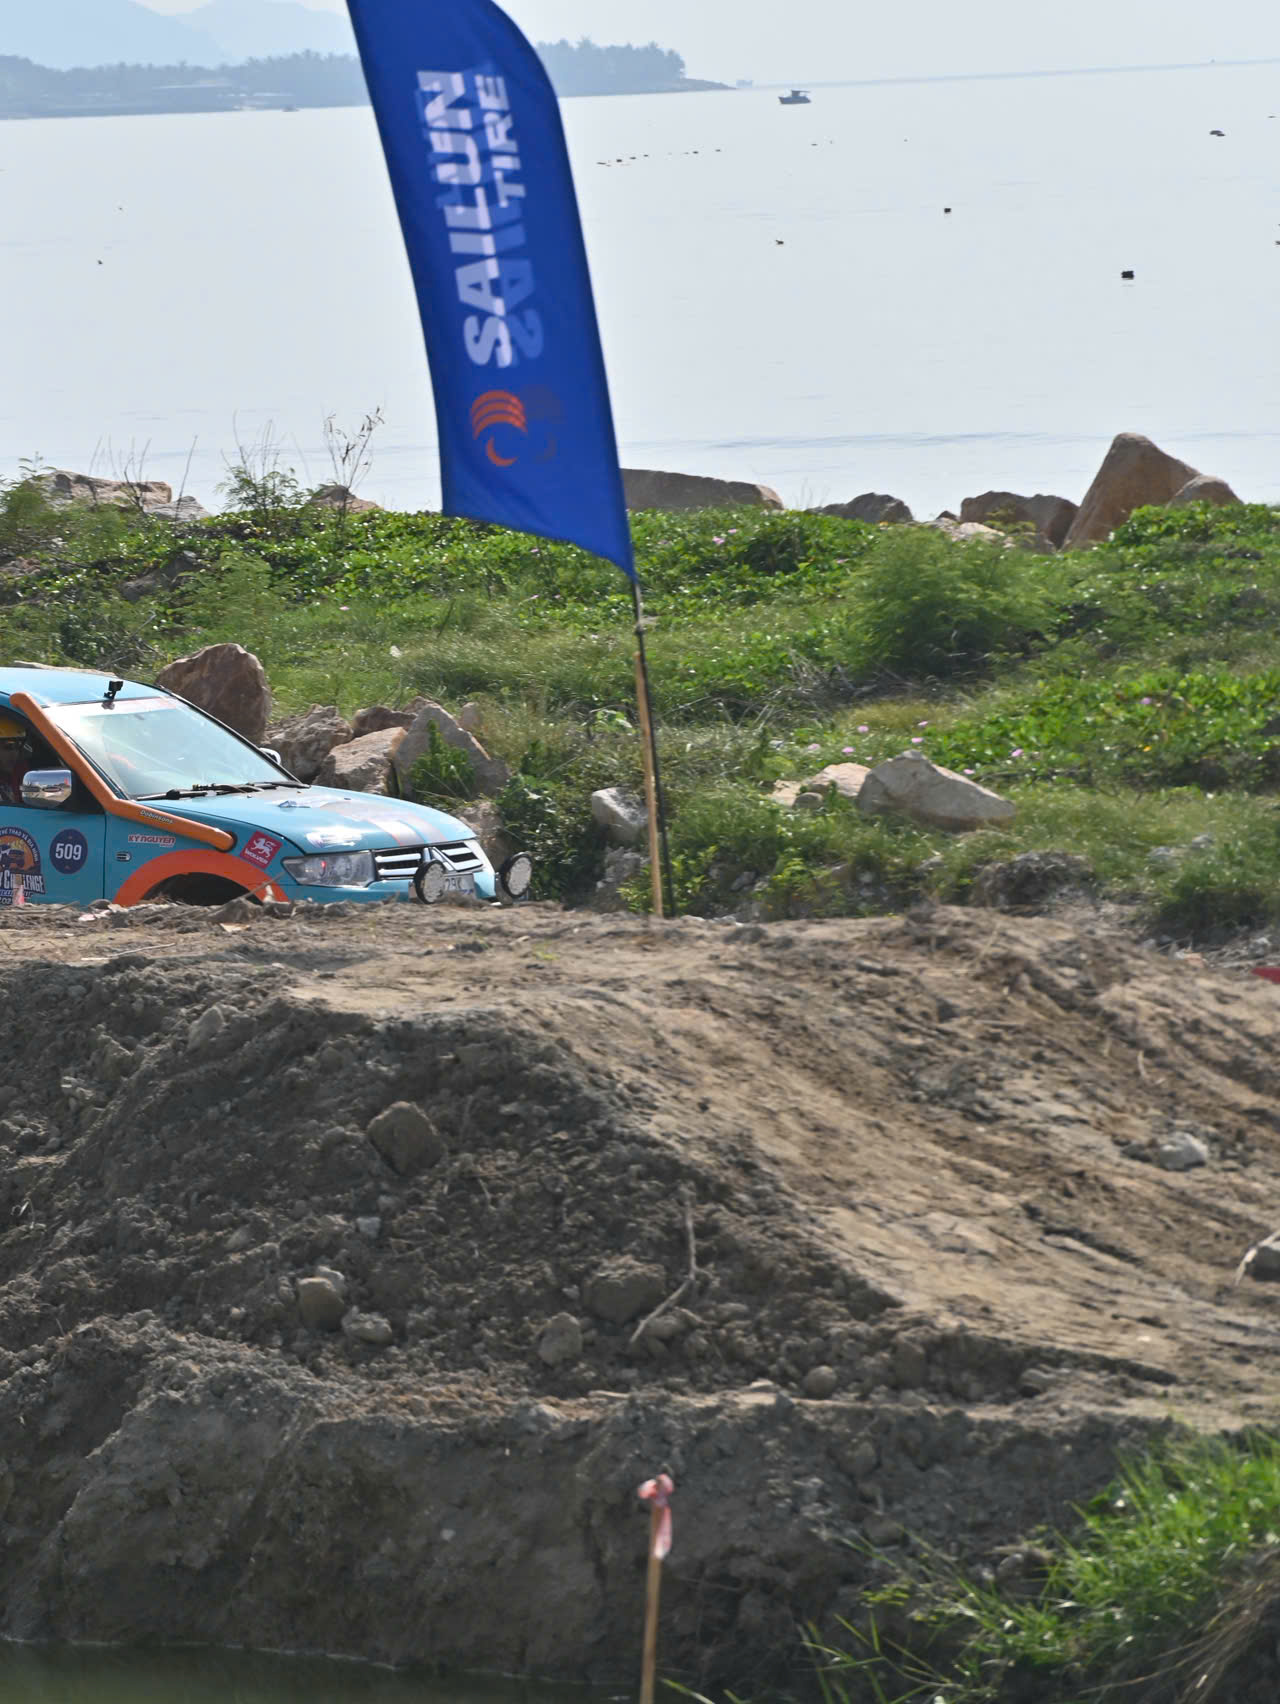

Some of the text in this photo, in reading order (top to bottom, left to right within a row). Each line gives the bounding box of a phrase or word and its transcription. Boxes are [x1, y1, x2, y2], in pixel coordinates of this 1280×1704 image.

[474, 75, 526, 207] TIRE
[417, 71, 513, 368] SAILUN
[55, 843, 82, 861] 509
